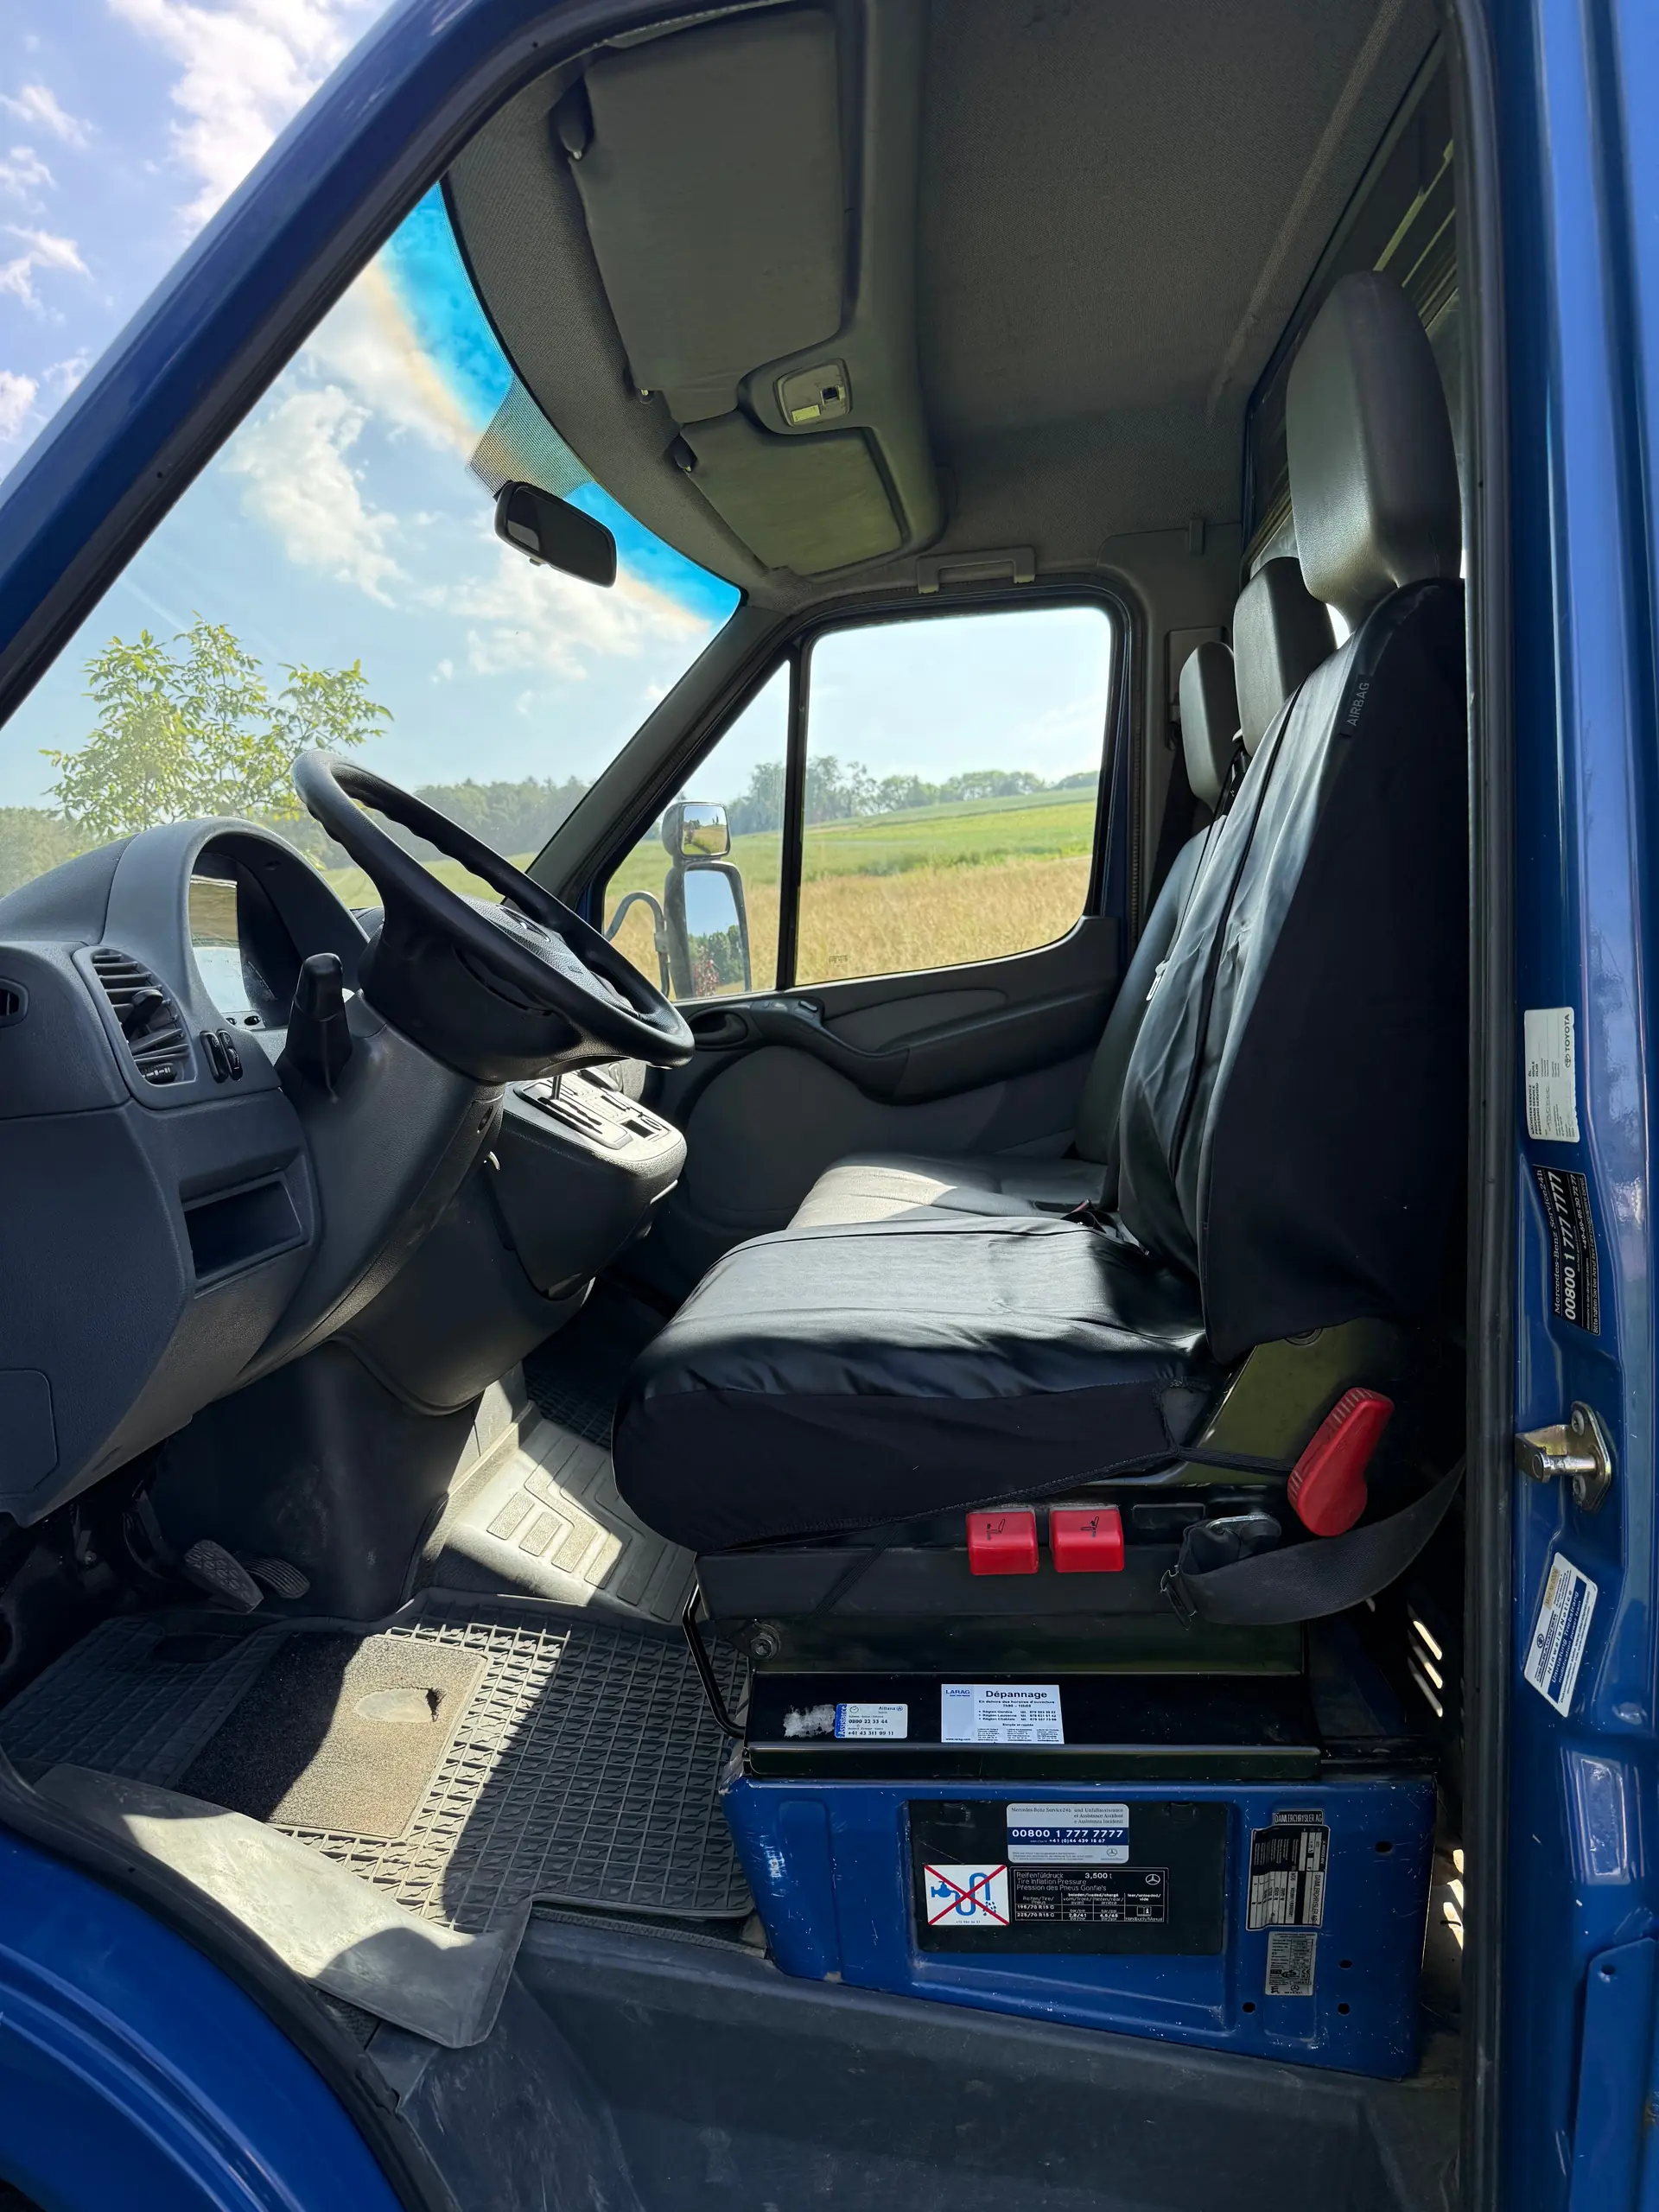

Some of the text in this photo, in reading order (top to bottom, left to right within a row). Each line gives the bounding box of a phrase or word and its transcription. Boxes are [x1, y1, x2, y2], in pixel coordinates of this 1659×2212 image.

[1347, 682, 1370, 727] AIRBAG
[1548, 1171, 1568, 1215] 7777
[1570, 1173, 1577, 1185] 77
[1573, 1185, 1580, 1197] 72
[1537, 1169, 1556, 1229] Service24h
[1574, 1197, 1581, 1209] 30
[1559, 1216, 1574, 1249] 777
[1564, 1266, 1576, 1320] 00800
[1548, 1590, 1572, 1674] Hinweis/Notice
[1552, 1591, 1580, 1683] Umrüstung Triebstrang
[986, 1690, 1047, 1700] Dépannage
[837, 1706, 847, 1738] Assistance
[1093, 1829, 1123, 1838] 7777
[1274, 1814, 1323, 1823] DAIMLERCHRYSLER AG
